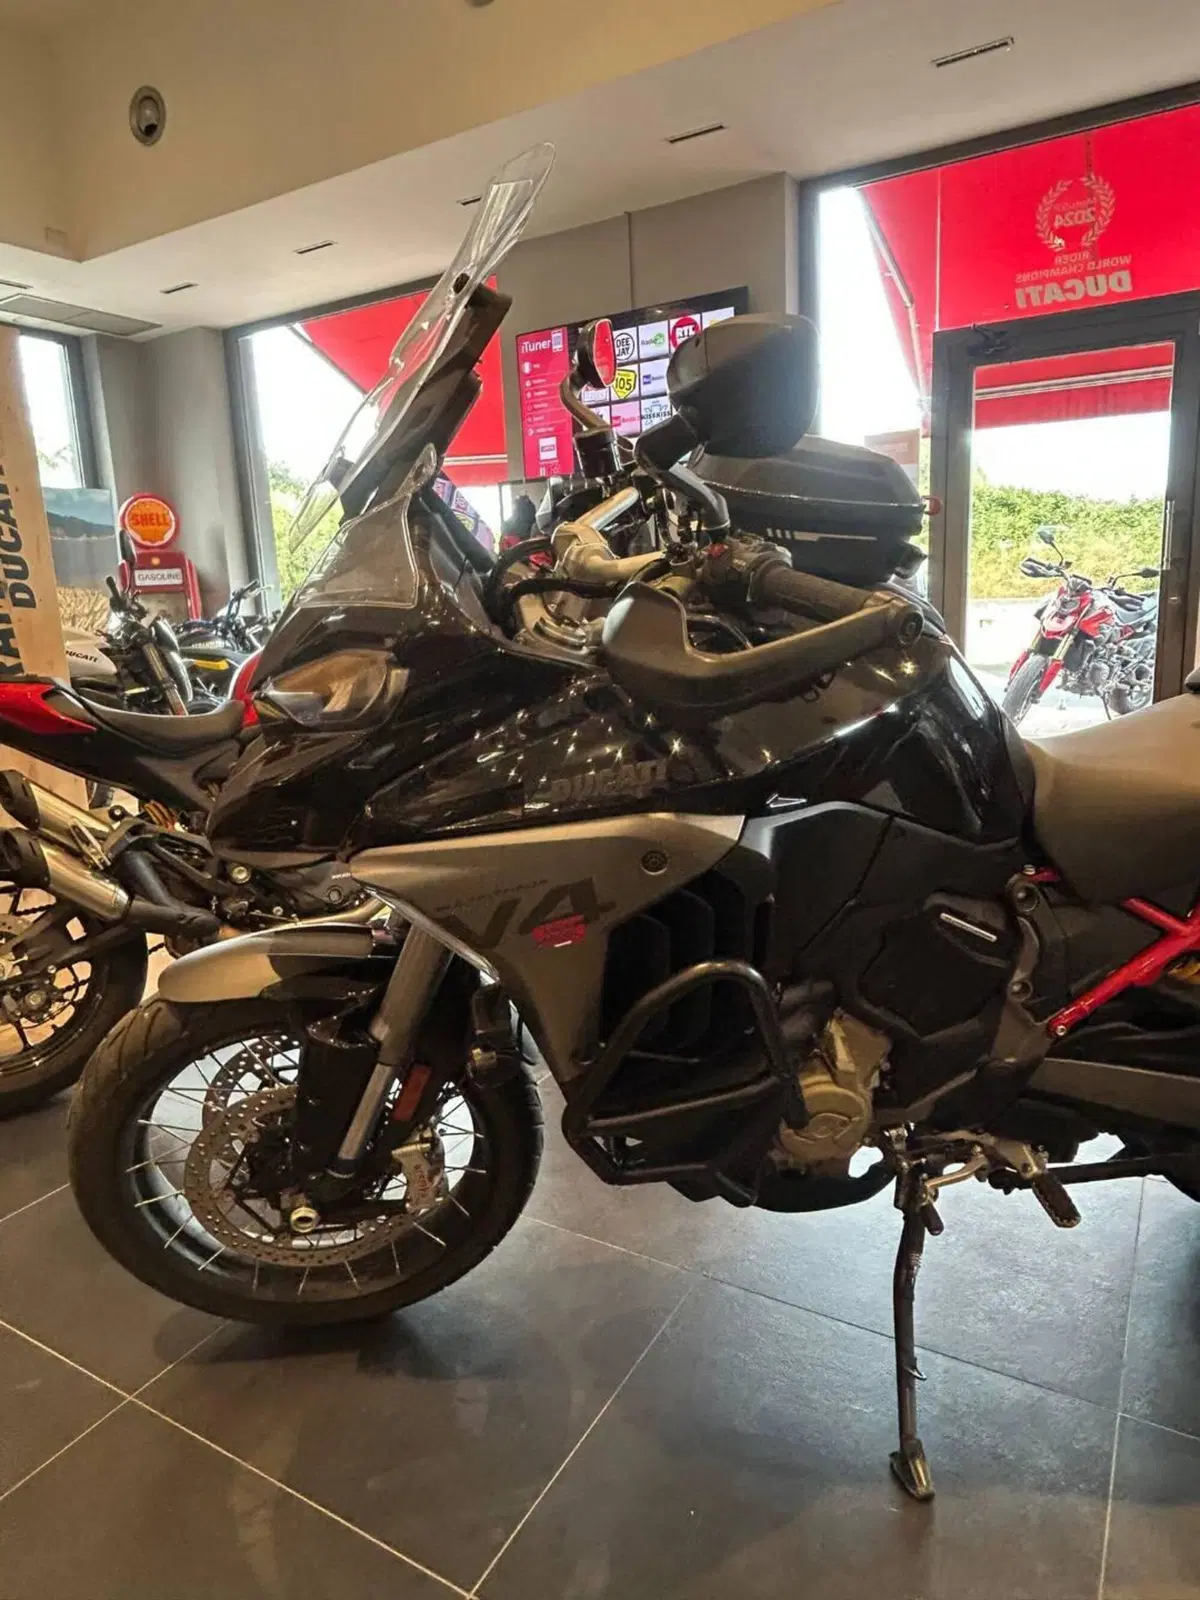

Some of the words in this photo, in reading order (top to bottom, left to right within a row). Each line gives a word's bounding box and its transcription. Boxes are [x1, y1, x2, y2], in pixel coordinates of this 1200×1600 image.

[521, 340, 551, 353] iTuner
[616, 337, 630, 348] DEE
[616, 346, 631, 357] JAY
[615, 376, 632, 392] 105
[131, 511, 169, 527] SHELL
[137, 570, 182, 582] GASOLINE
[65, 650, 98, 663] UCATI
